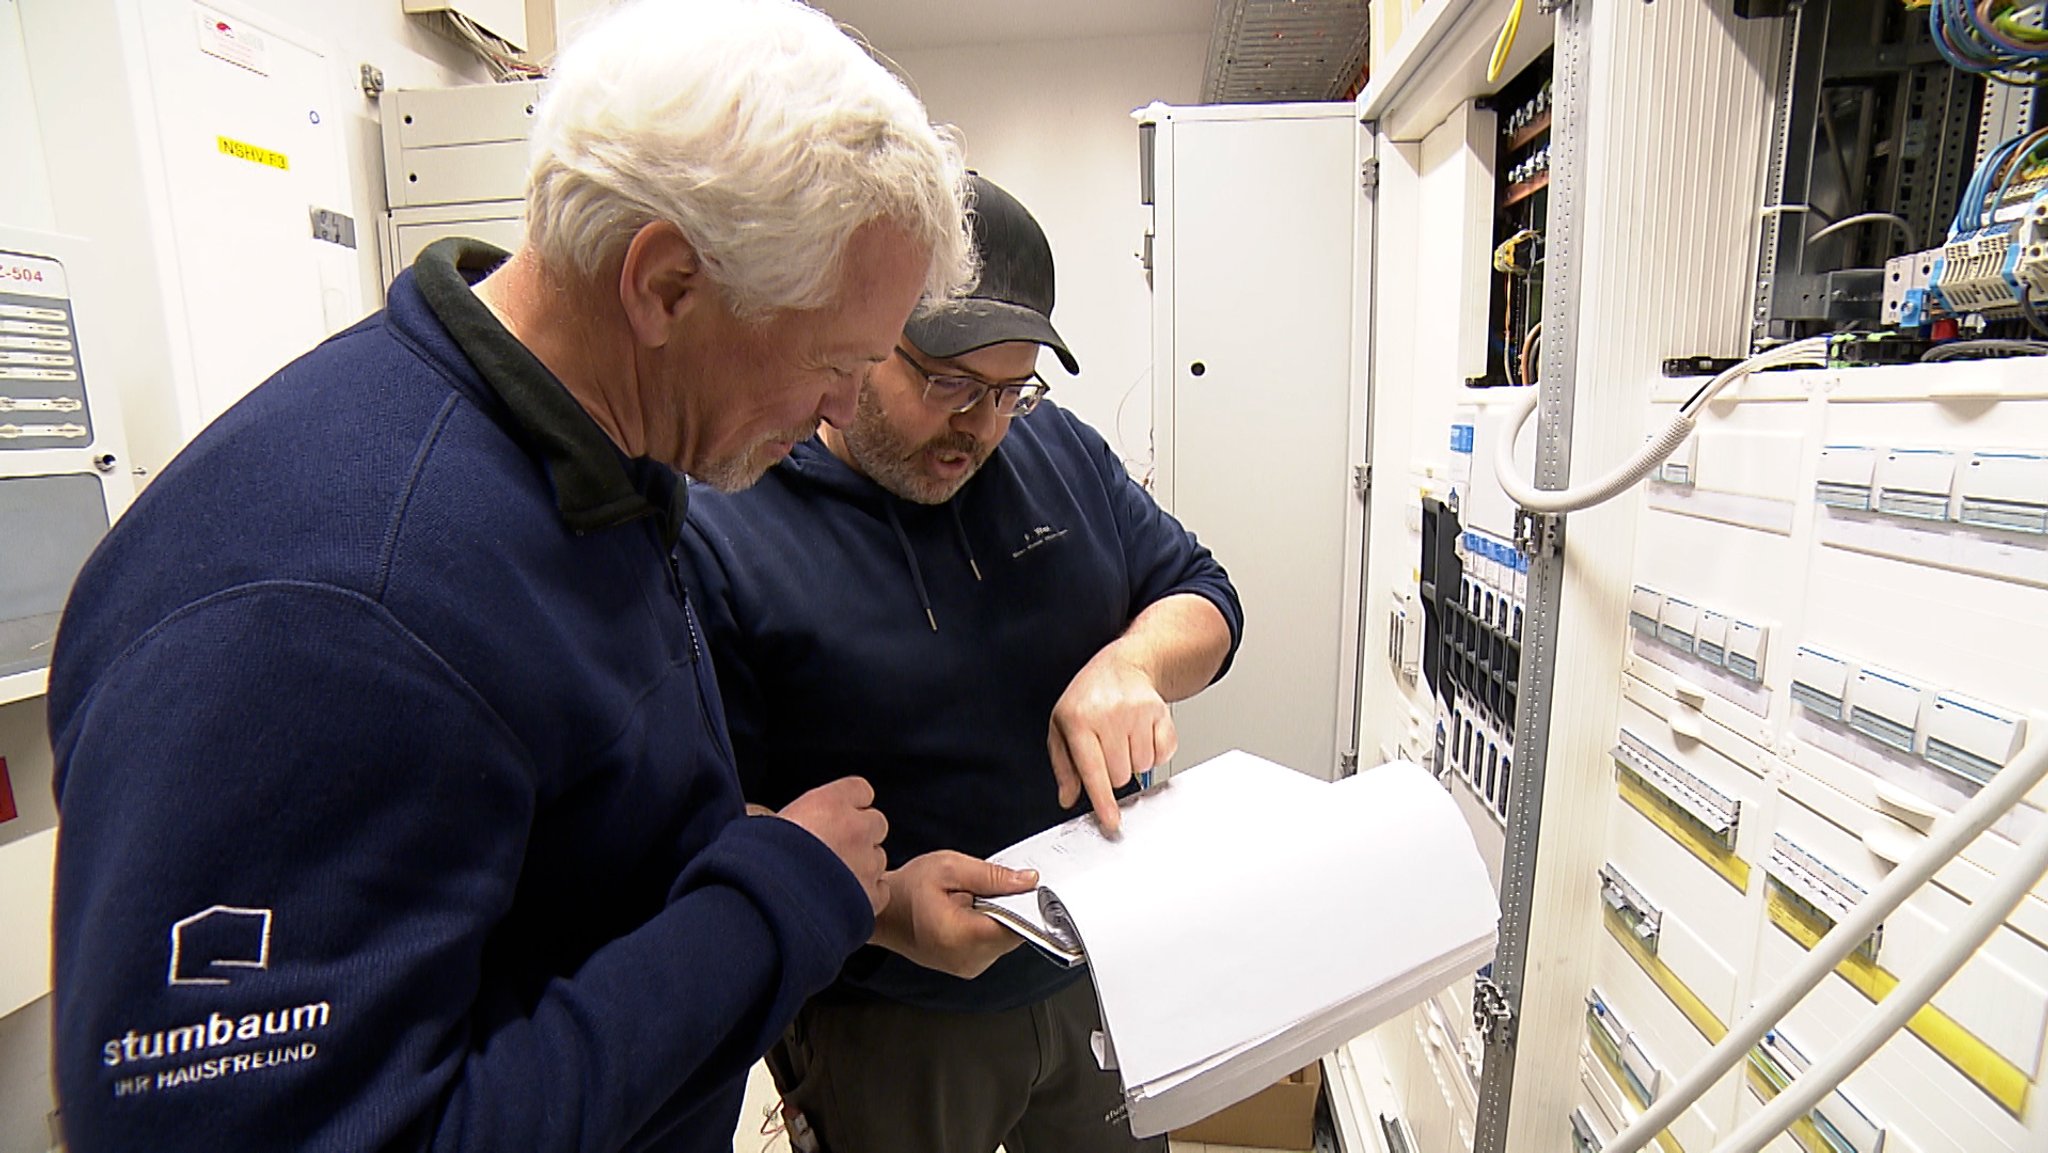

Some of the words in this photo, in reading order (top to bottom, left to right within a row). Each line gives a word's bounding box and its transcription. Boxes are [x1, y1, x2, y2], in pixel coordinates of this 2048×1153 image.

[223, 140, 264, 163] NSHV
[103, 1001, 330, 1066] stumbaum
[114, 1077, 150, 1097] IHR
[156, 1042, 317, 1090] HAUSFREUND
